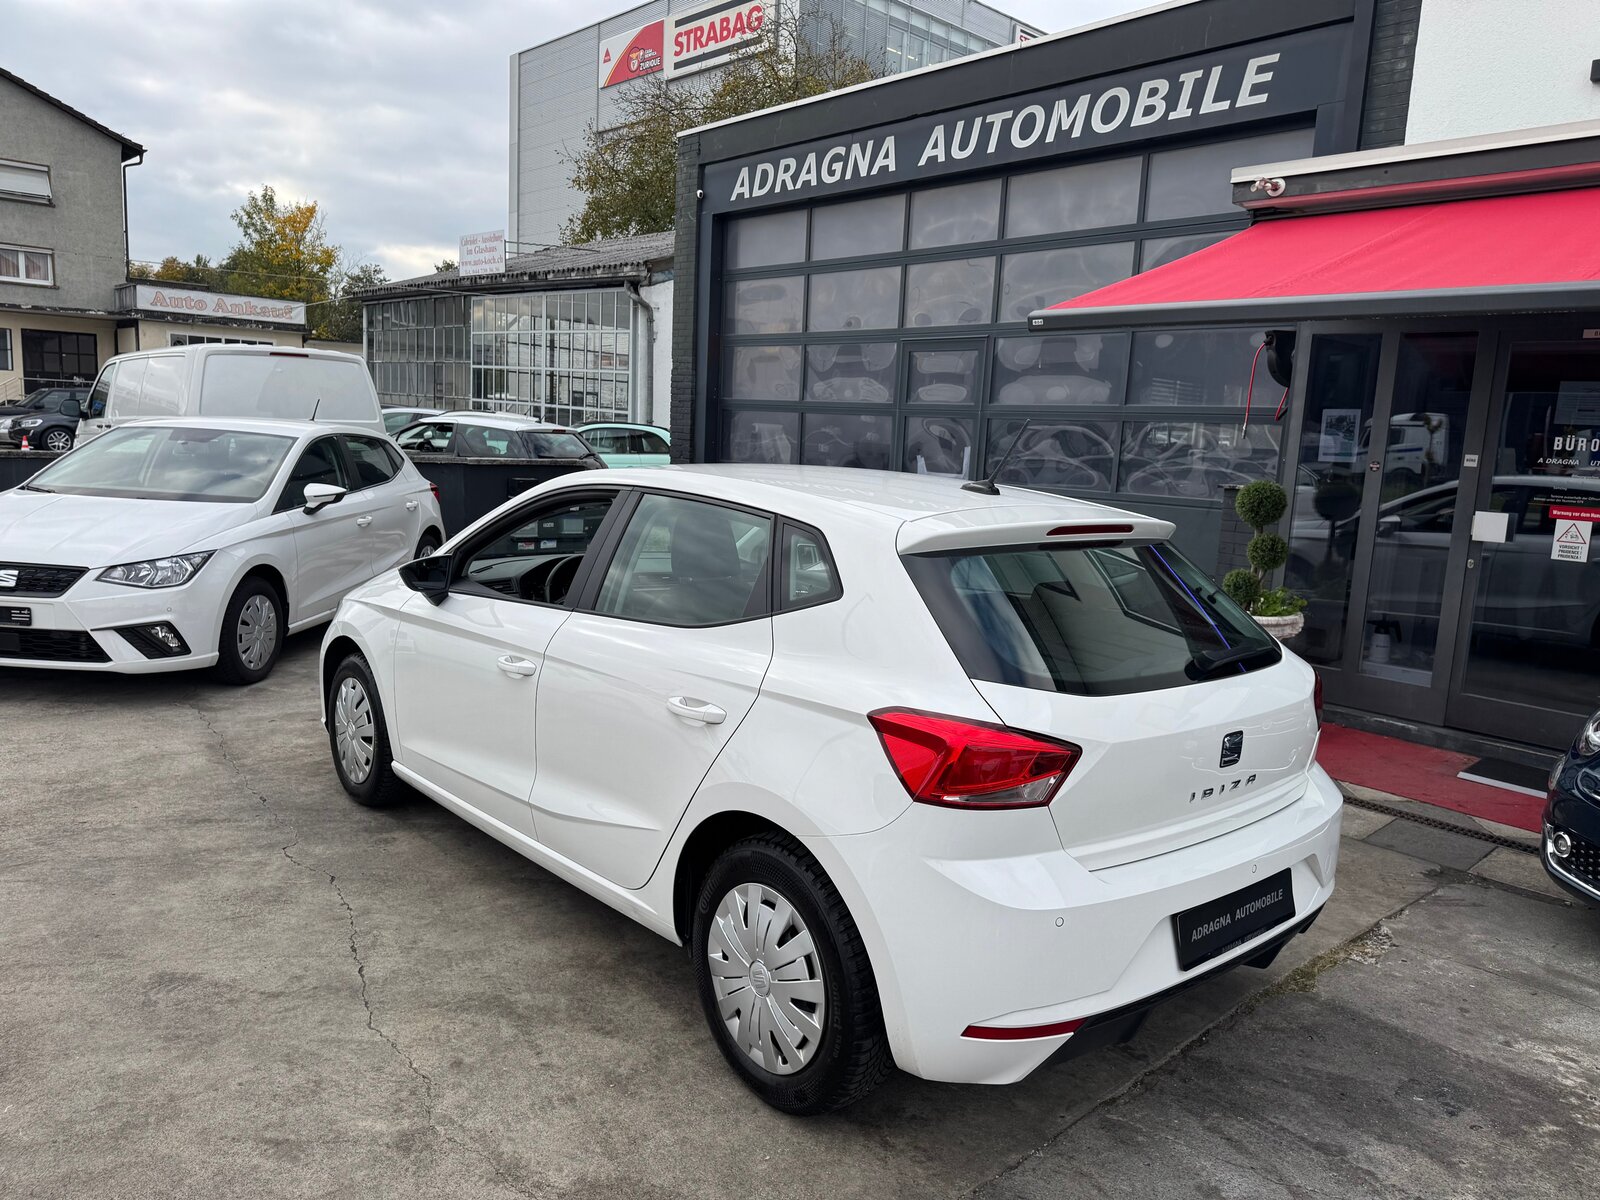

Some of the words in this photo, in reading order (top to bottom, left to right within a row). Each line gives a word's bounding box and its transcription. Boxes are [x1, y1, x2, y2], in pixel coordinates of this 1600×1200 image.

[673, 5, 764, 57] STRABAG
[640, 57, 661, 71] ZURIQUE
[730, 136, 896, 201] ADRAGNA
[918, 53, 1281, 167] AUTOMOBILE
[150, 291, 208, 311] Auto
[212, 298, 293, 320] Ankauf
[1553, 434, 1600, 452] BÜRO
[1189, 774, 1257, 802] IBIZA
[1191, 914, 1232, 942] ADRAGNA
[1235, 888, 1284, 920] AUTOMOBILE
